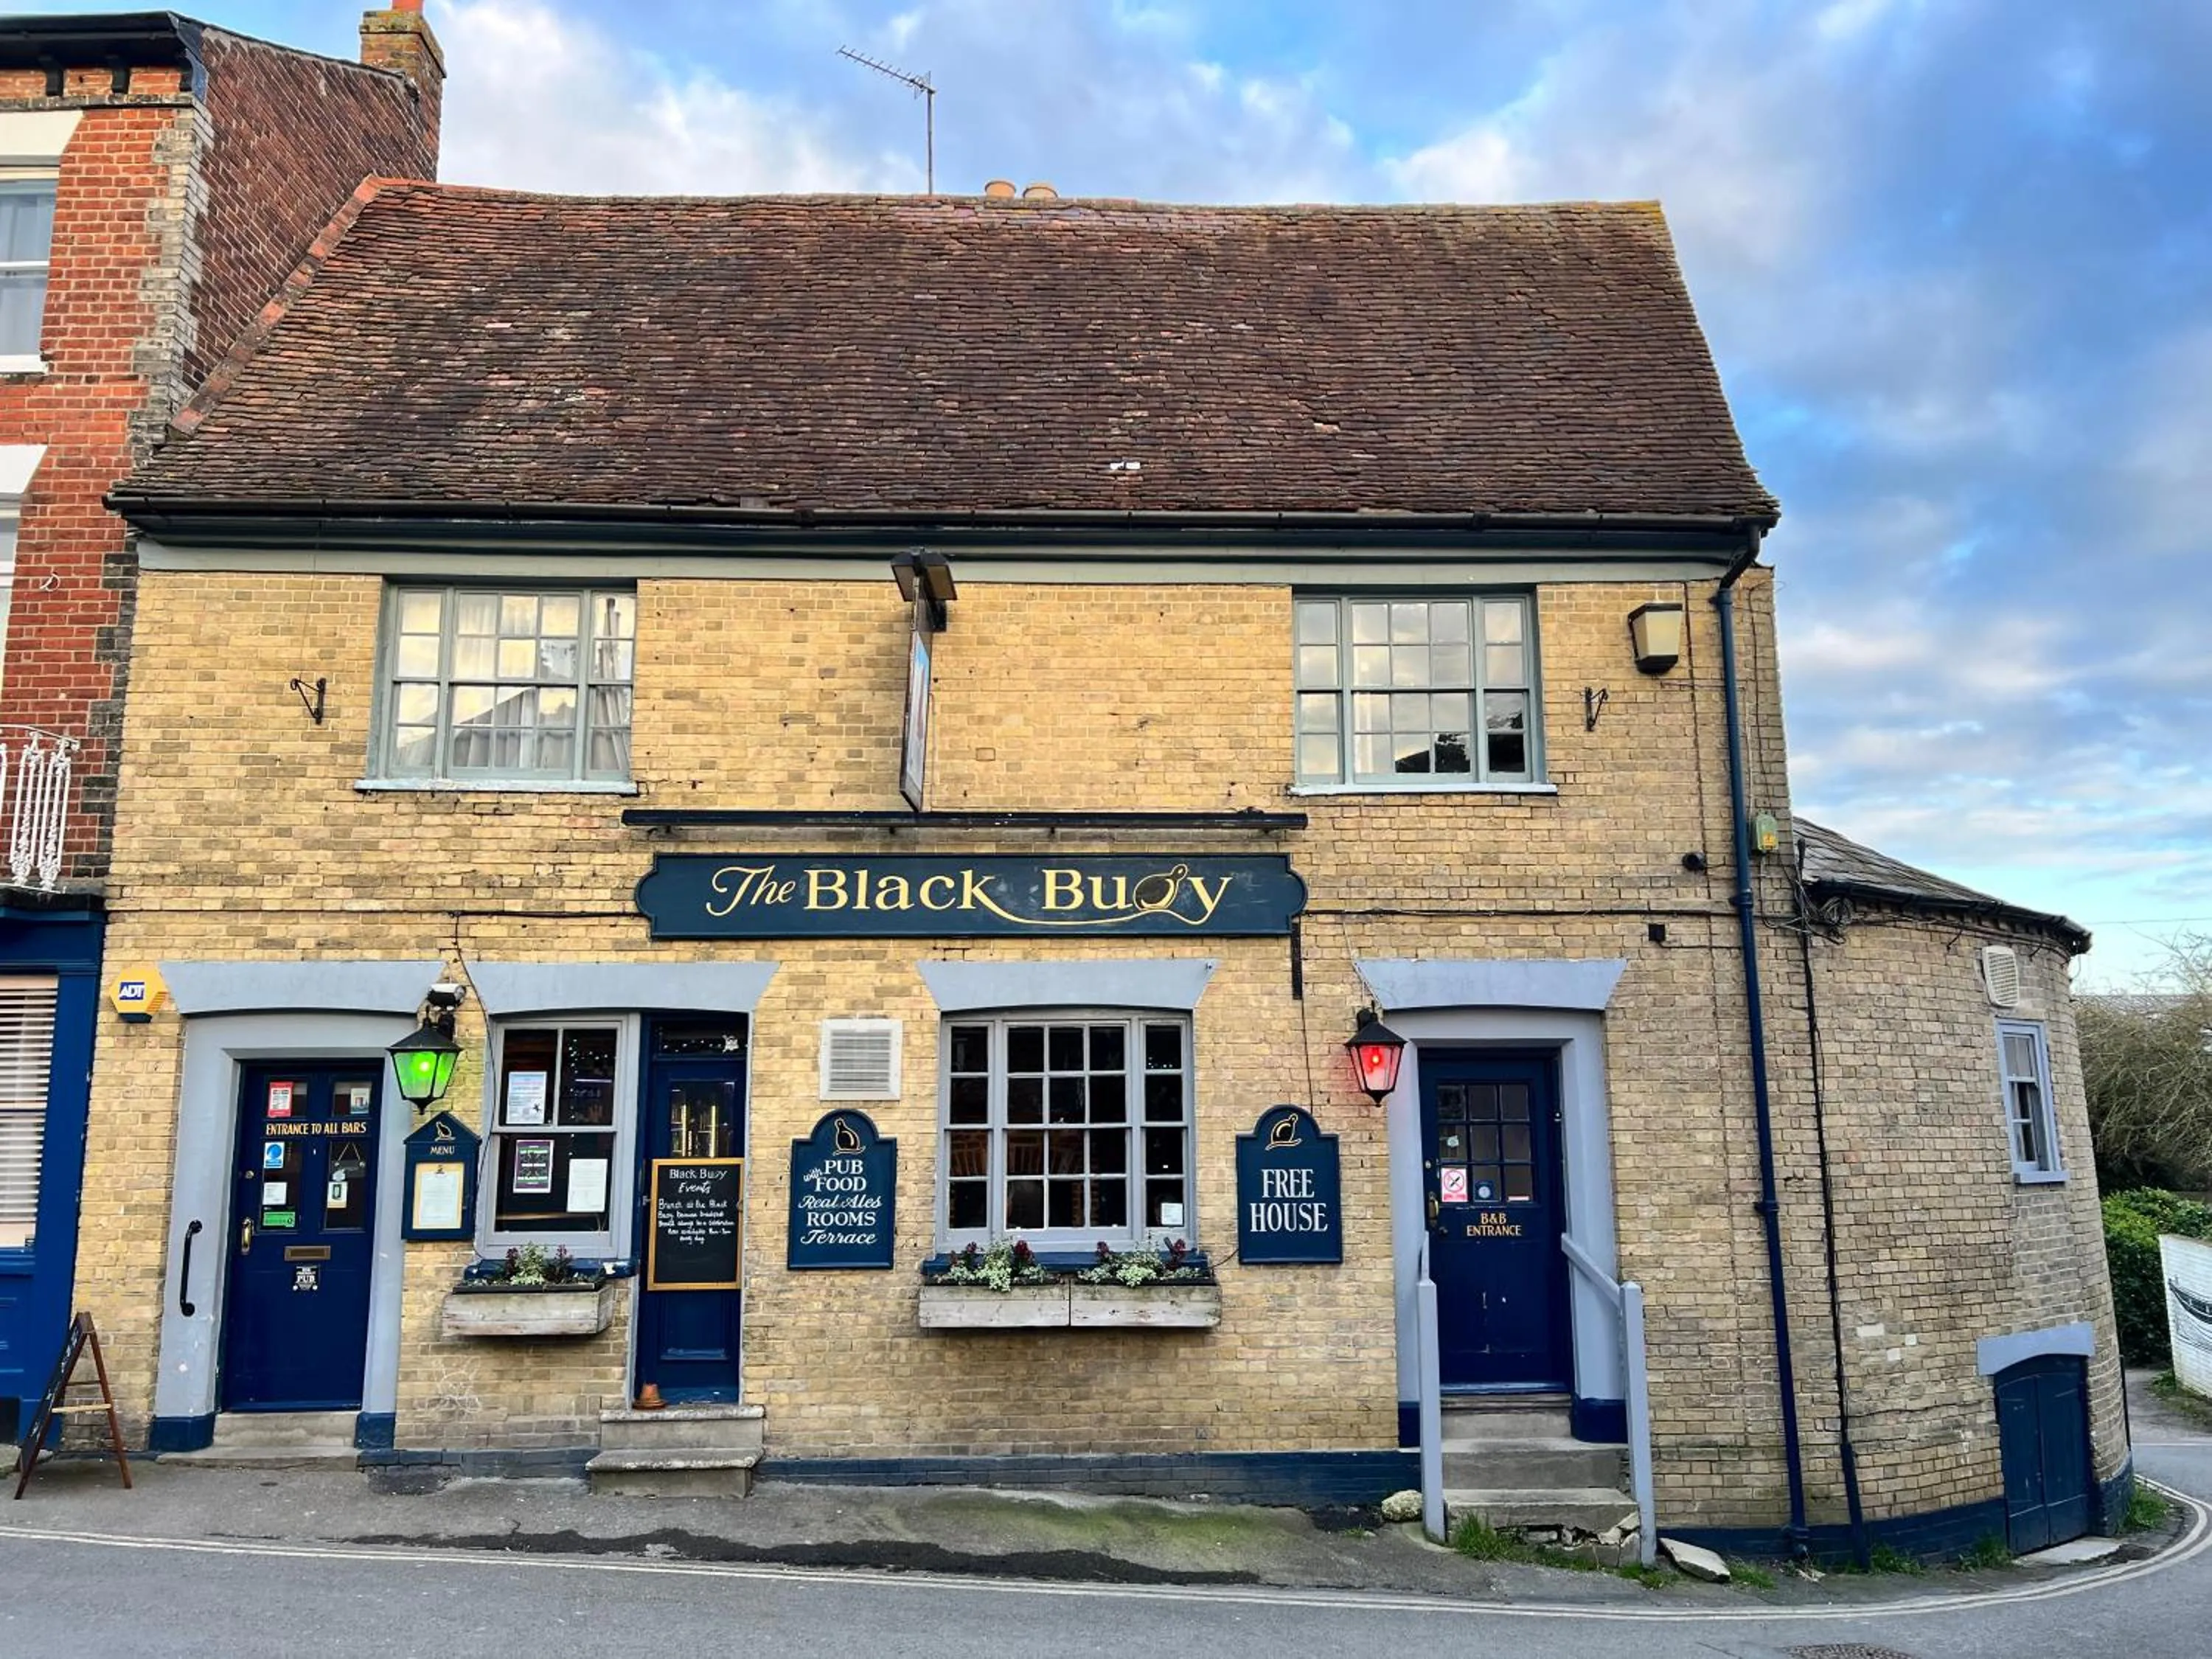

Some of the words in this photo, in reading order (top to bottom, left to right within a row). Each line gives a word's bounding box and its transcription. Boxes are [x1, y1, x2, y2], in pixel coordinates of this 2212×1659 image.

[706, 864, 796, 917] The
[803, 869, 1014, 919] Black
[1042, 863, 1233, 925] Buoy
[119, 984, 145, 998] ADT
[265, 1123, 309, 1135] ENTRANCE
[311, 1123, 322, 1134] TO
[324, 1122, 338, 1134] ALL
[341, 1121, 366, 1133] BARS
[430, 1145, 456, 1155] MENU
[669, 1169, 697, 1179] Black
[824, 1159, 863, 1175] PUB
[803, 1167, 824, 1182] with
[814, 1176, 867, 1192] FOOD
[1261, 1169, 1315, 1198] FREE
[678, 1181, 712, 1194] Events
[798, 1194, 841, 1210] Real
[841, 1194, 883, 1209] Ales
[807, 1211, 877, 1227] ROOMS
[1250, 1203, 1328, 1232] HOUSE
[1481, 1212, 1507, 1225] B&B
[800, 1228, 878, 1245] Terrace
[1467, 1225, 1523, 1237] ENTRANCE
[296, 1275, 316, 1284] PUB
